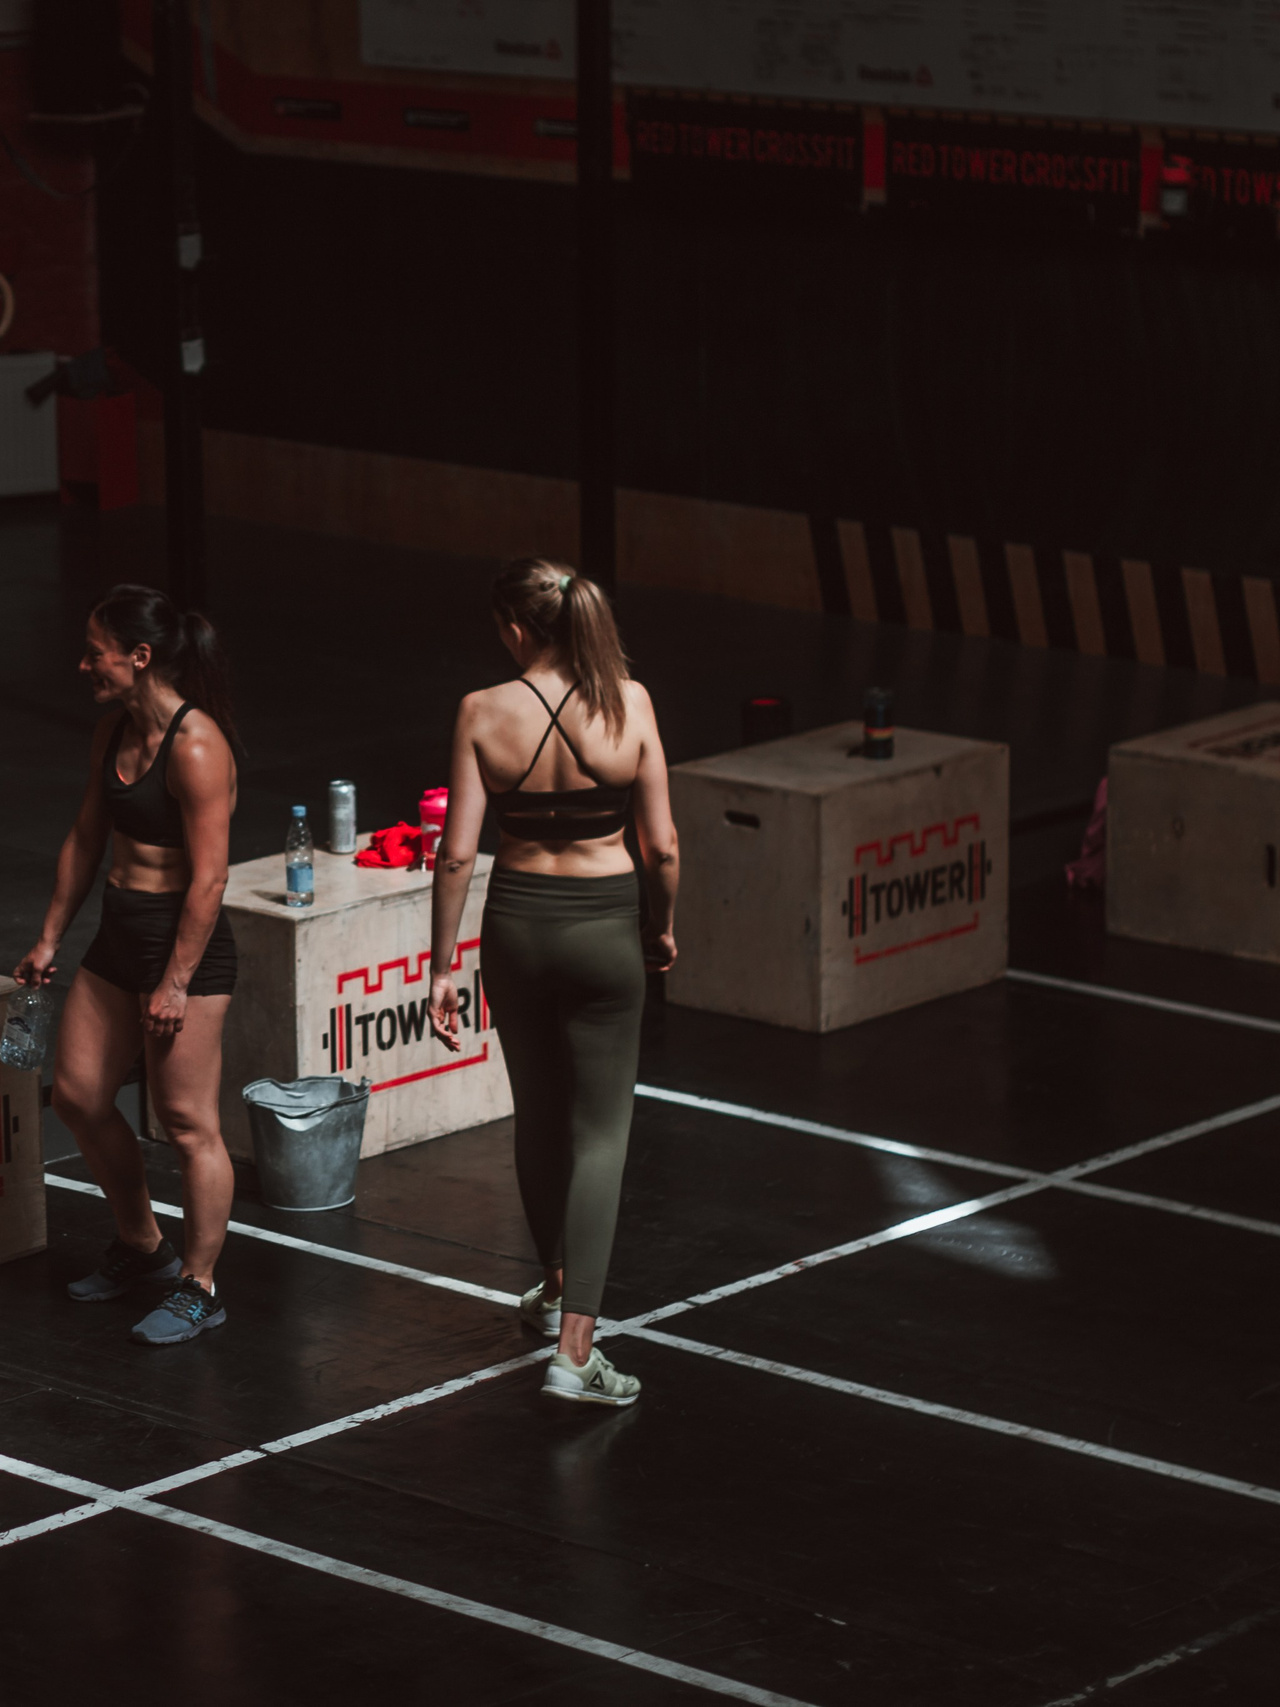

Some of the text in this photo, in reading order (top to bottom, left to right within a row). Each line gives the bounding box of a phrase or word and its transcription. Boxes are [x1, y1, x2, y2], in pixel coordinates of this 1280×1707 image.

[892, 140, 1130, 193] RED TOWER CROSSFIT
[869, 860, 966, 923] TOWER
[355, 987, 471, 1057] TOWR
